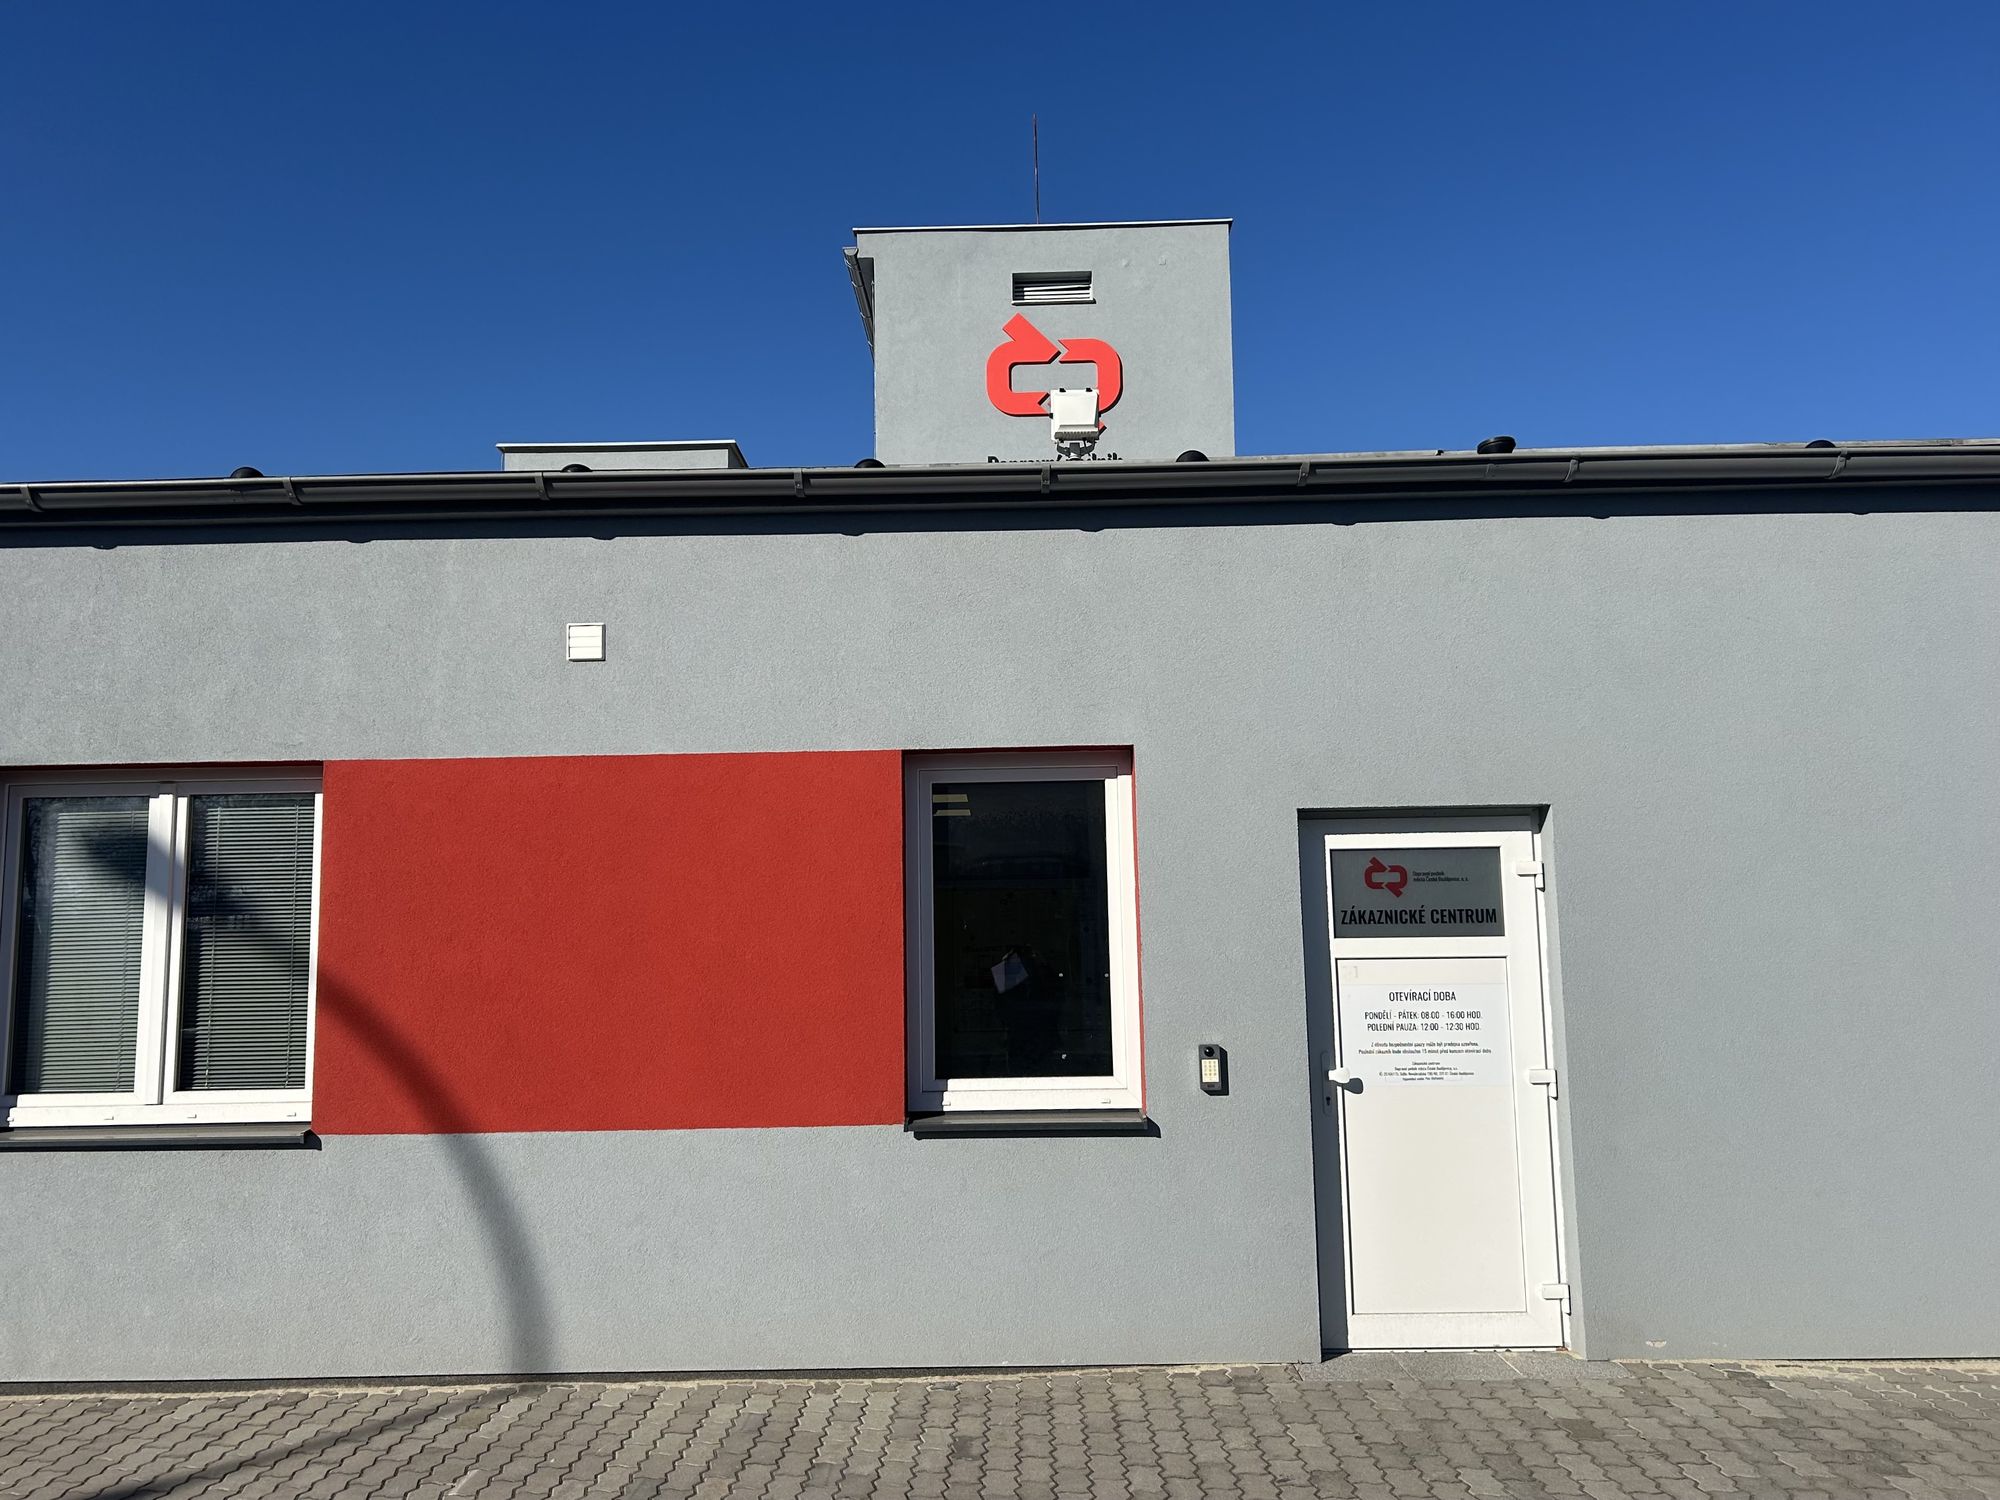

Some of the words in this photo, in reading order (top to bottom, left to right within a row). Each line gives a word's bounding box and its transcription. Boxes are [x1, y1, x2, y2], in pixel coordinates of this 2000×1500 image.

[1340, 905, 1426, 925] ZÁKAZNICKÉ
[1430, 908, 1497, 924] CENTRUM
[1388, 988, 1431, 1002] OTEVÍRACÍ
[1433, 991, 1457, 1002] DOBA
[1364, 1009, 1392, 1020] PONDĚLÍ
[1398, 1009, 1419, 1020] PÁTEK:
[1446, 1010, 1465, 1019] 16:00
[1466, 1010, 1483, 1019] HOD.
[1367, 1021, 1395, 1032] POLEDNÍ
[1420, 1022, 1439, 1031] 12:00
[1446, 1022, 1464, 1031] 12:30
[1465, 1022, 1482, 1031] HOD.
